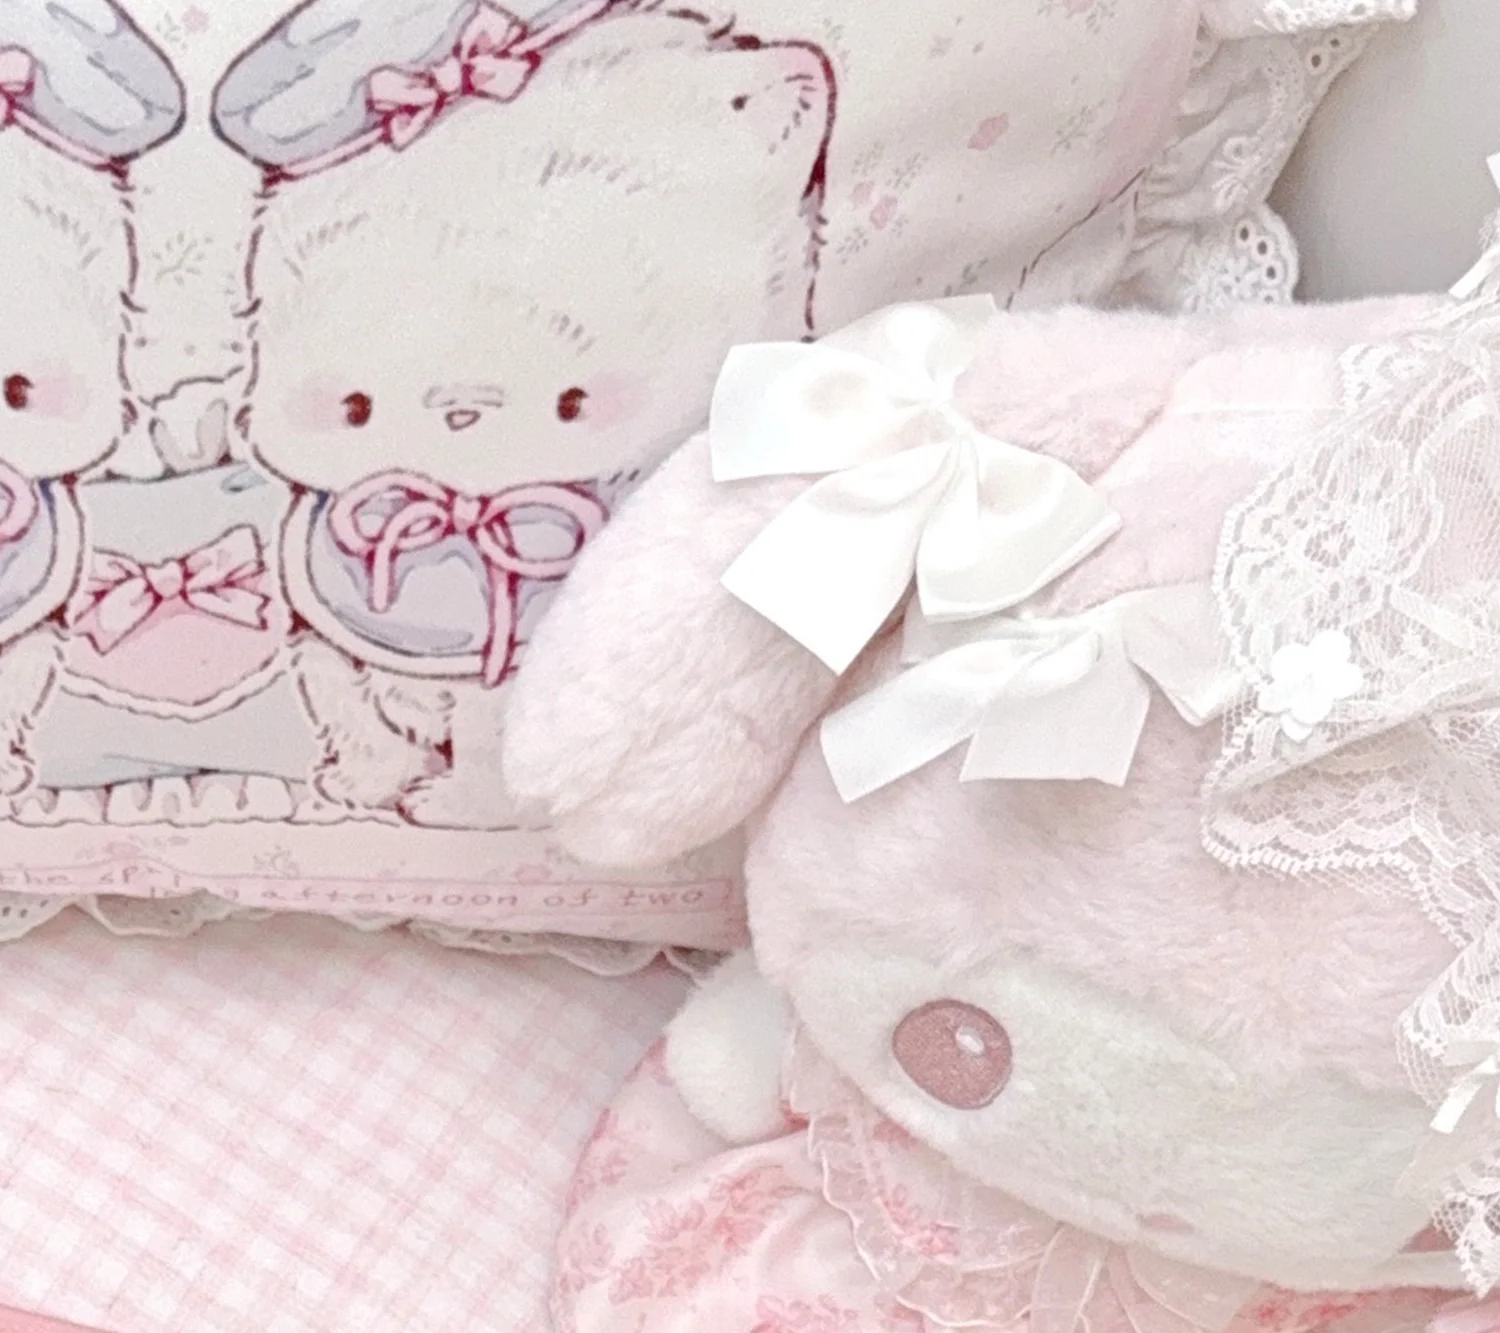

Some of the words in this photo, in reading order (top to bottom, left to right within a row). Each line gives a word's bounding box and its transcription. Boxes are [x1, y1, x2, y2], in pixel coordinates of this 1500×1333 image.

[261, 885, 518, 907] afternoon
[543, 886, 599, 908] of
[619, 888, 704, 909] two
